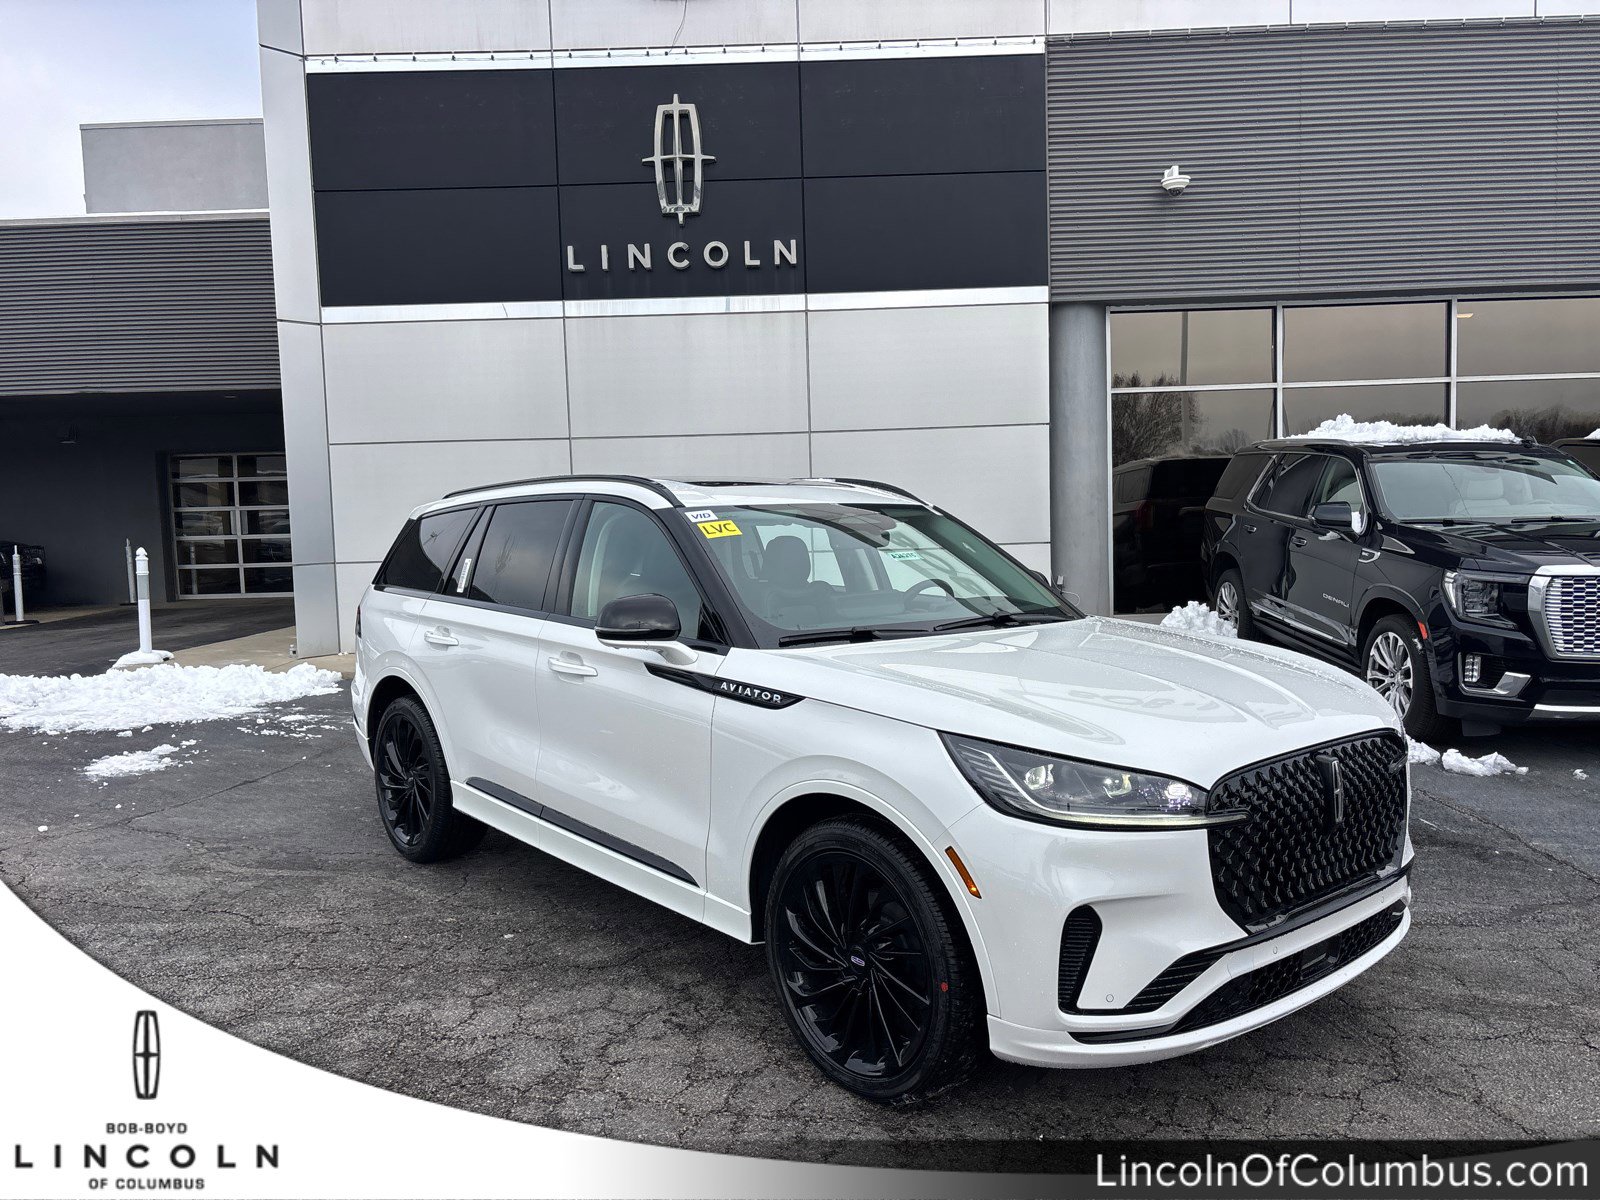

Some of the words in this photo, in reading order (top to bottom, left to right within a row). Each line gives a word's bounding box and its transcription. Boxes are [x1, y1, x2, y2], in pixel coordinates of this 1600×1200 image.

[567, 239, 798, 272] LINCOLN
[691, 512, 711, 520] VID
[702, 522, 736, 535] LVC
[1322, 592, 1350, 608] DENALI
[720, 681, 782, 704] AVIATOR
